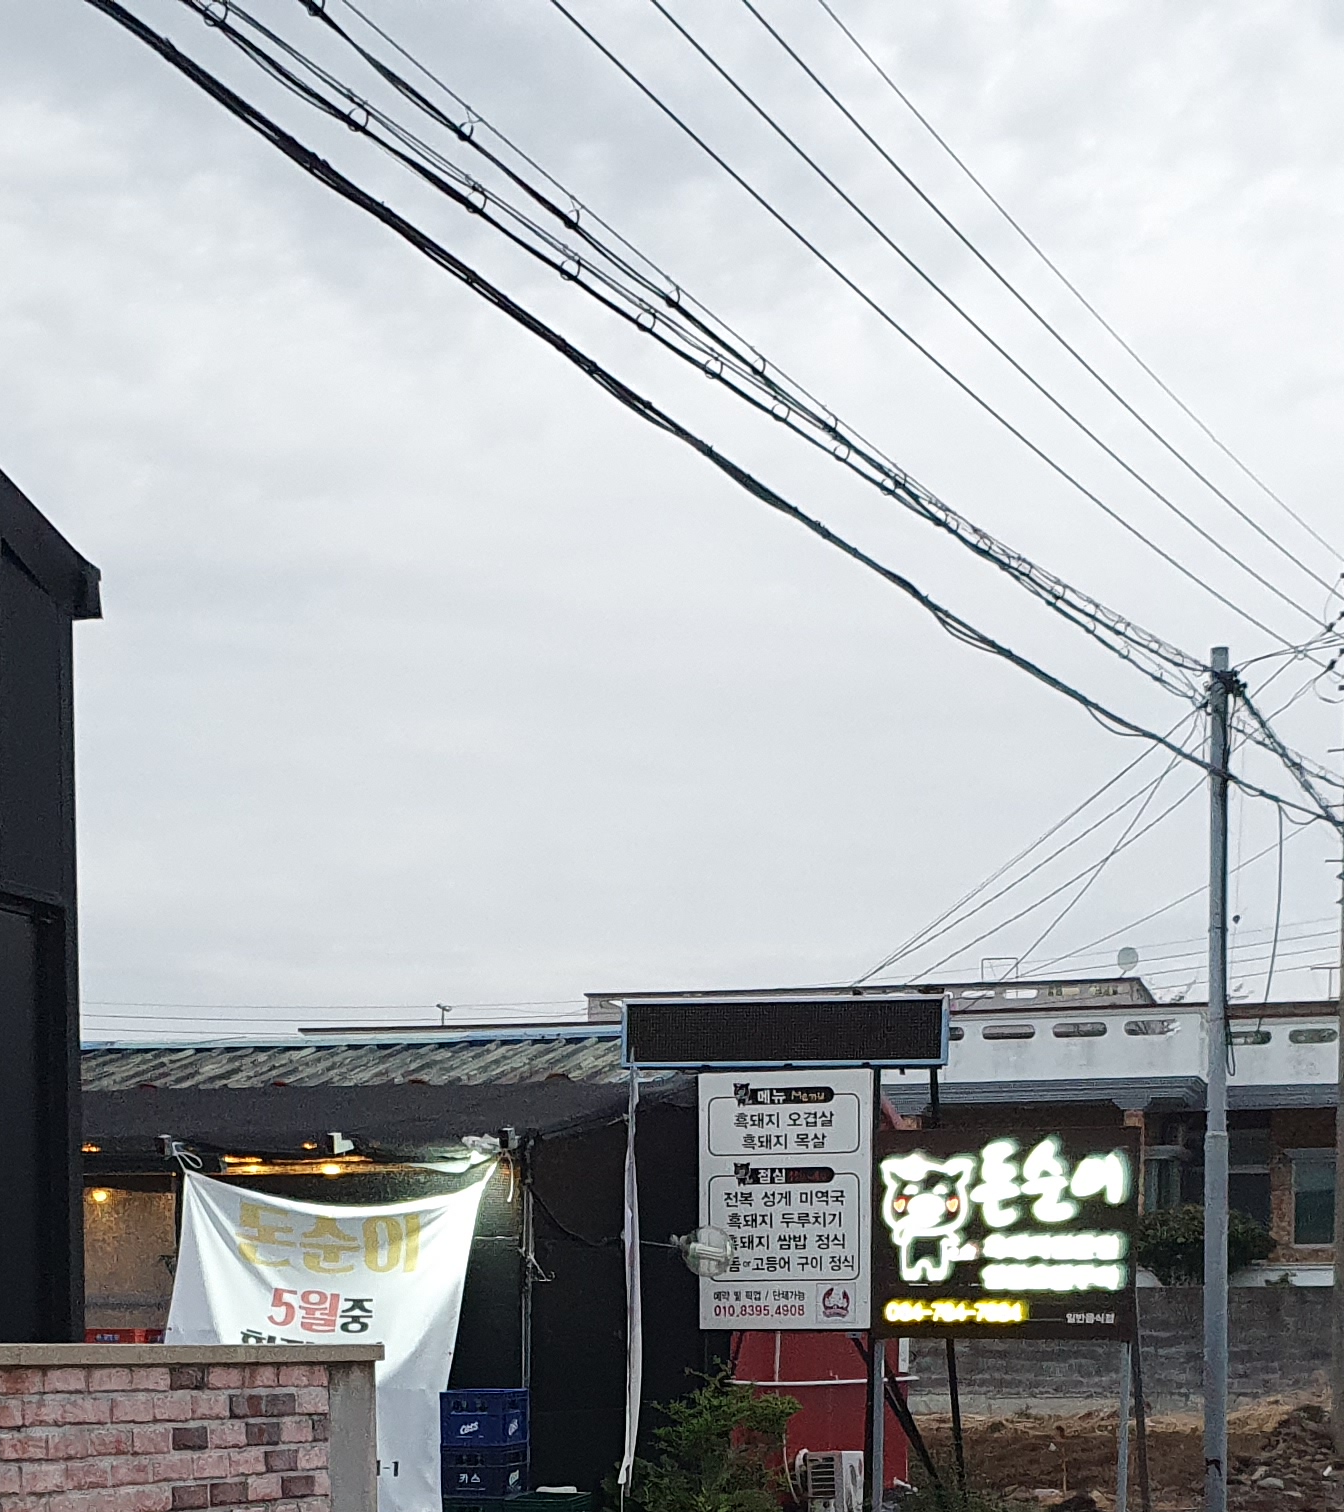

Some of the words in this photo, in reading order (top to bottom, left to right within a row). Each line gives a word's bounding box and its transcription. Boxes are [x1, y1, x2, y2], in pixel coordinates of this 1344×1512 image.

[757, 1089, 787, 1104] 메뉴
[733, 1112, 780, 1129] 흑돼지
[786, 1111, 835, 1128] 오겹살
[741, 1133, 788, 1150] 흑돼지
[794, 1132, 828, 1149] 목살
[757, 1168, 786, 1184] 점심
[723, 1191, 754, 1208] 전복
[761, 1191, 792, 1207] 성게
[799, 1190, 846, 1206] 미역국
[726, 1212, 773, 1229] 흑돼지
[780, 1211, 843, 1228] 두루치기
[235, 1201, 421, 1276] 돈순이
[776, 1234, 808, 1251] 쌈밥
[815, 1233, 846, 1250] 정식
[796, 1256, 823, 1272] 구이
[828, 1255, 855, 1272] 정식
